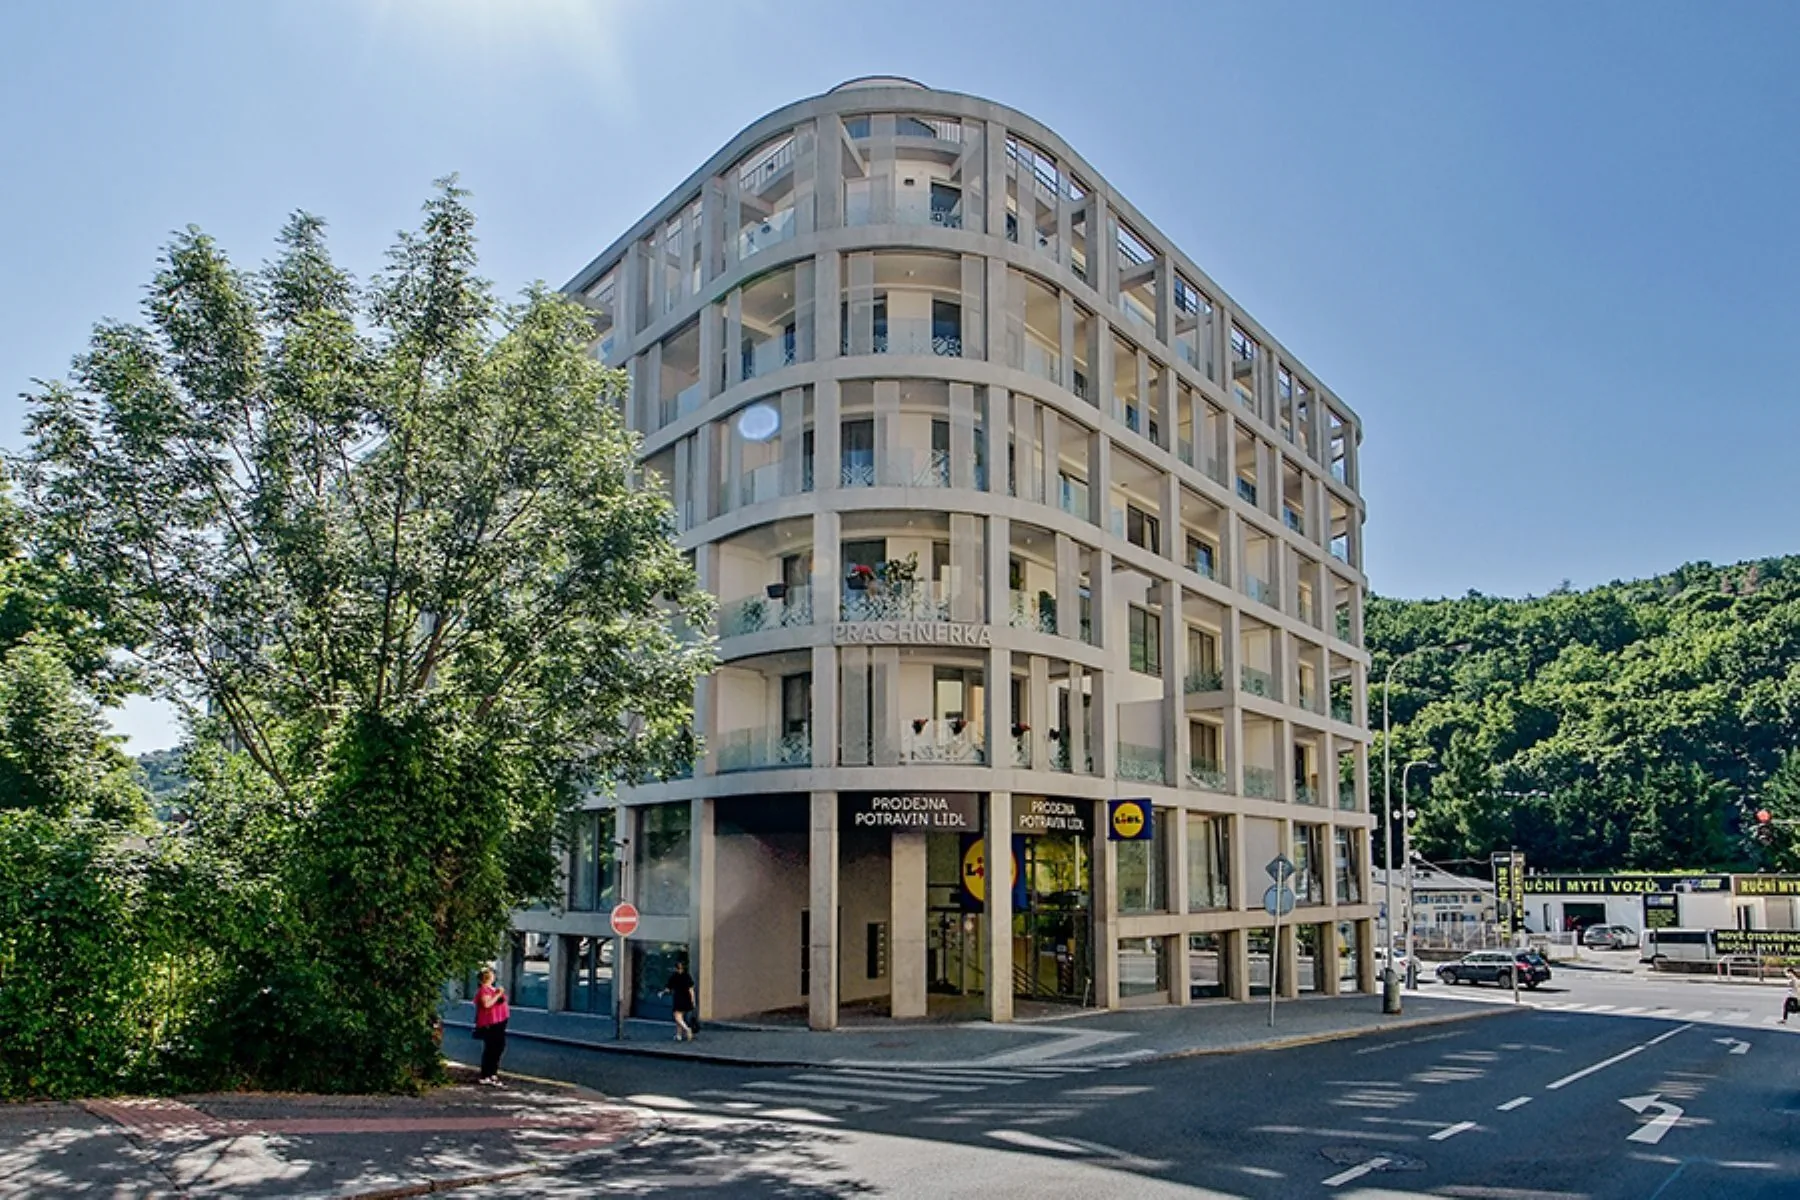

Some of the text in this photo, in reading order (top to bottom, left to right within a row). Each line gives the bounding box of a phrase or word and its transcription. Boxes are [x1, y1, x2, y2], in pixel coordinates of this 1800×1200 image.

[833, 621, 992, 645] PRACHNERKA
[872, 797, 949, 810] PRODEJNA
[855, 812, 966, 826] POTRAVIN LIDL
[1524, 877, 1560, 893] UČNÍ
[1566, 878, 1604, 893] MYTÍ
